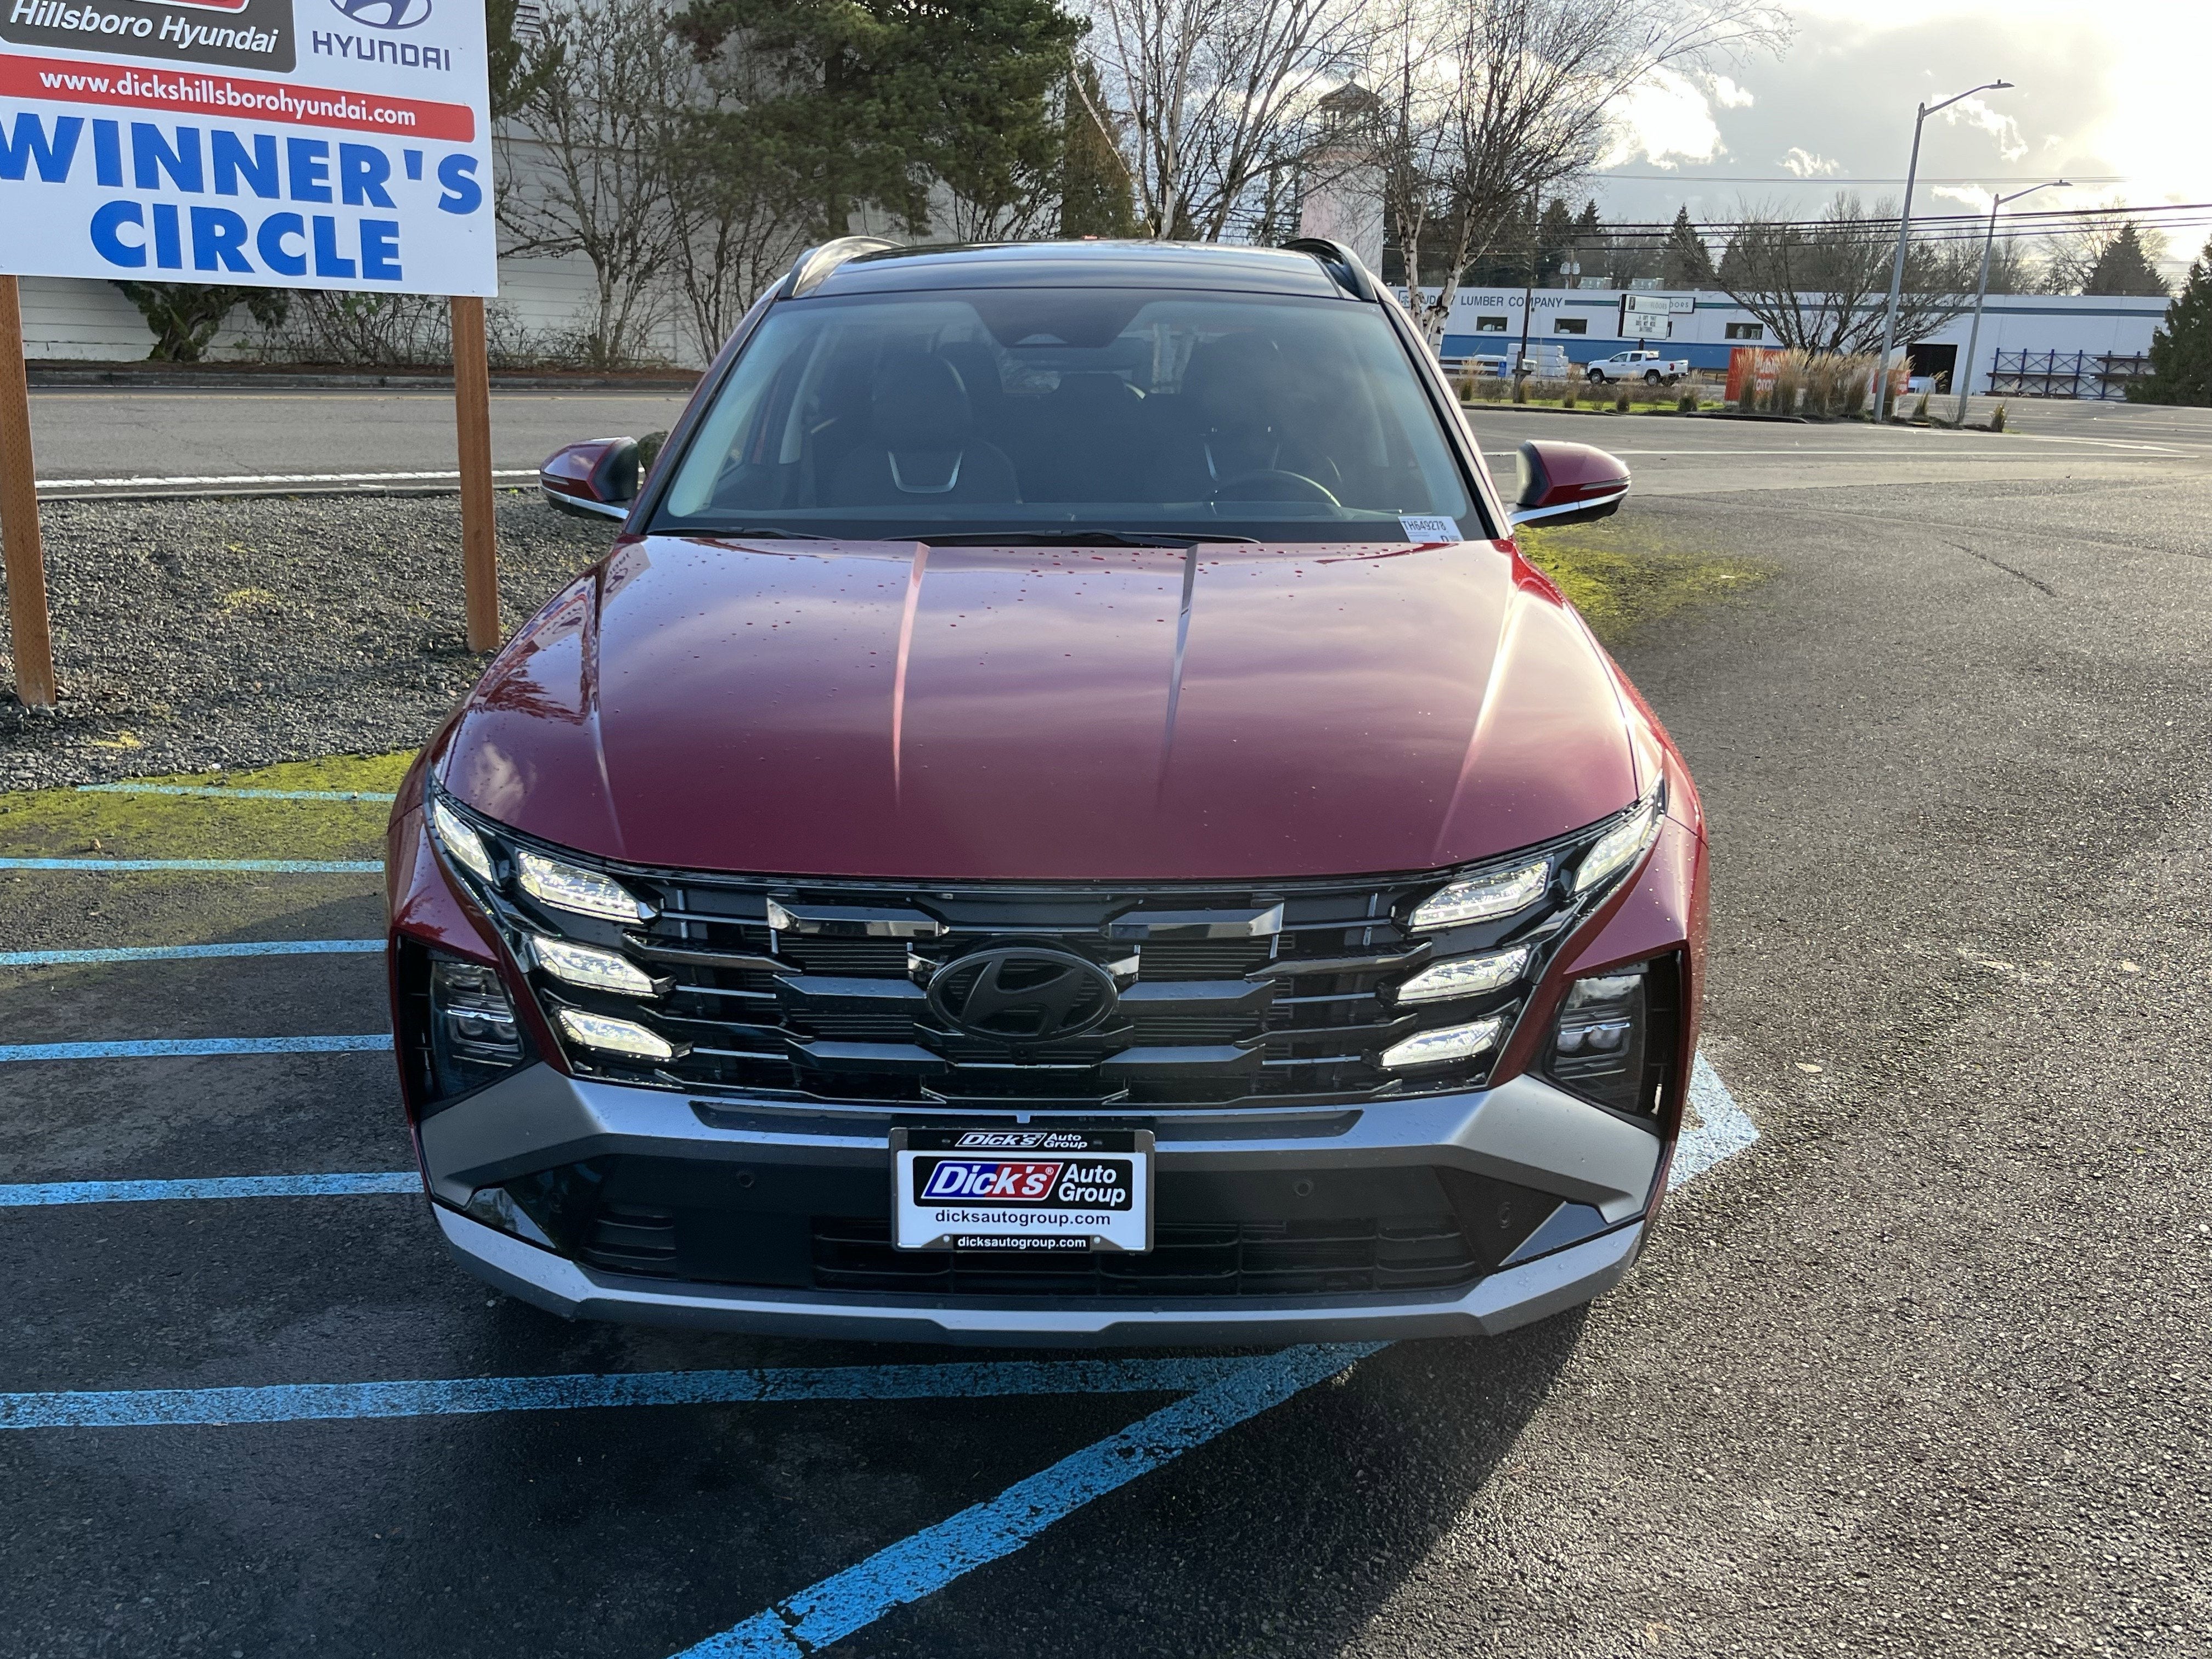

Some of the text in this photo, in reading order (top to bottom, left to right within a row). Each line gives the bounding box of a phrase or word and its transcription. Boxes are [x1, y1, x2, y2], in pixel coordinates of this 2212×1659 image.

[10, 0, 279, 53] Hillsboro Hyundai
[312, 31, 451, 72] HYUNDAI
[40, 69, 416, 128] www.dickshillsborohyundai.com
[0, 112, 482, 215] WINNER'S
[90, 200, 403, 281] CIRCLE
[1461, 295, 1504, 307] LUMBER
[962, 1133, 1037, 1146] Dick's
[1043, 1140, 1087, 1149] Group
[1047, 1133, 1082, 1142] Auto
[932, 1164, 1048, 1195] Dick's
[1062, 1164, 1117, 1183] Auto
[1058, 1181, 1126, 1207] Group
[935, 1209, 1111, 1227] dicksautogroup.com
[957, 1237, 1087, 1249] dicksautogroup.com
